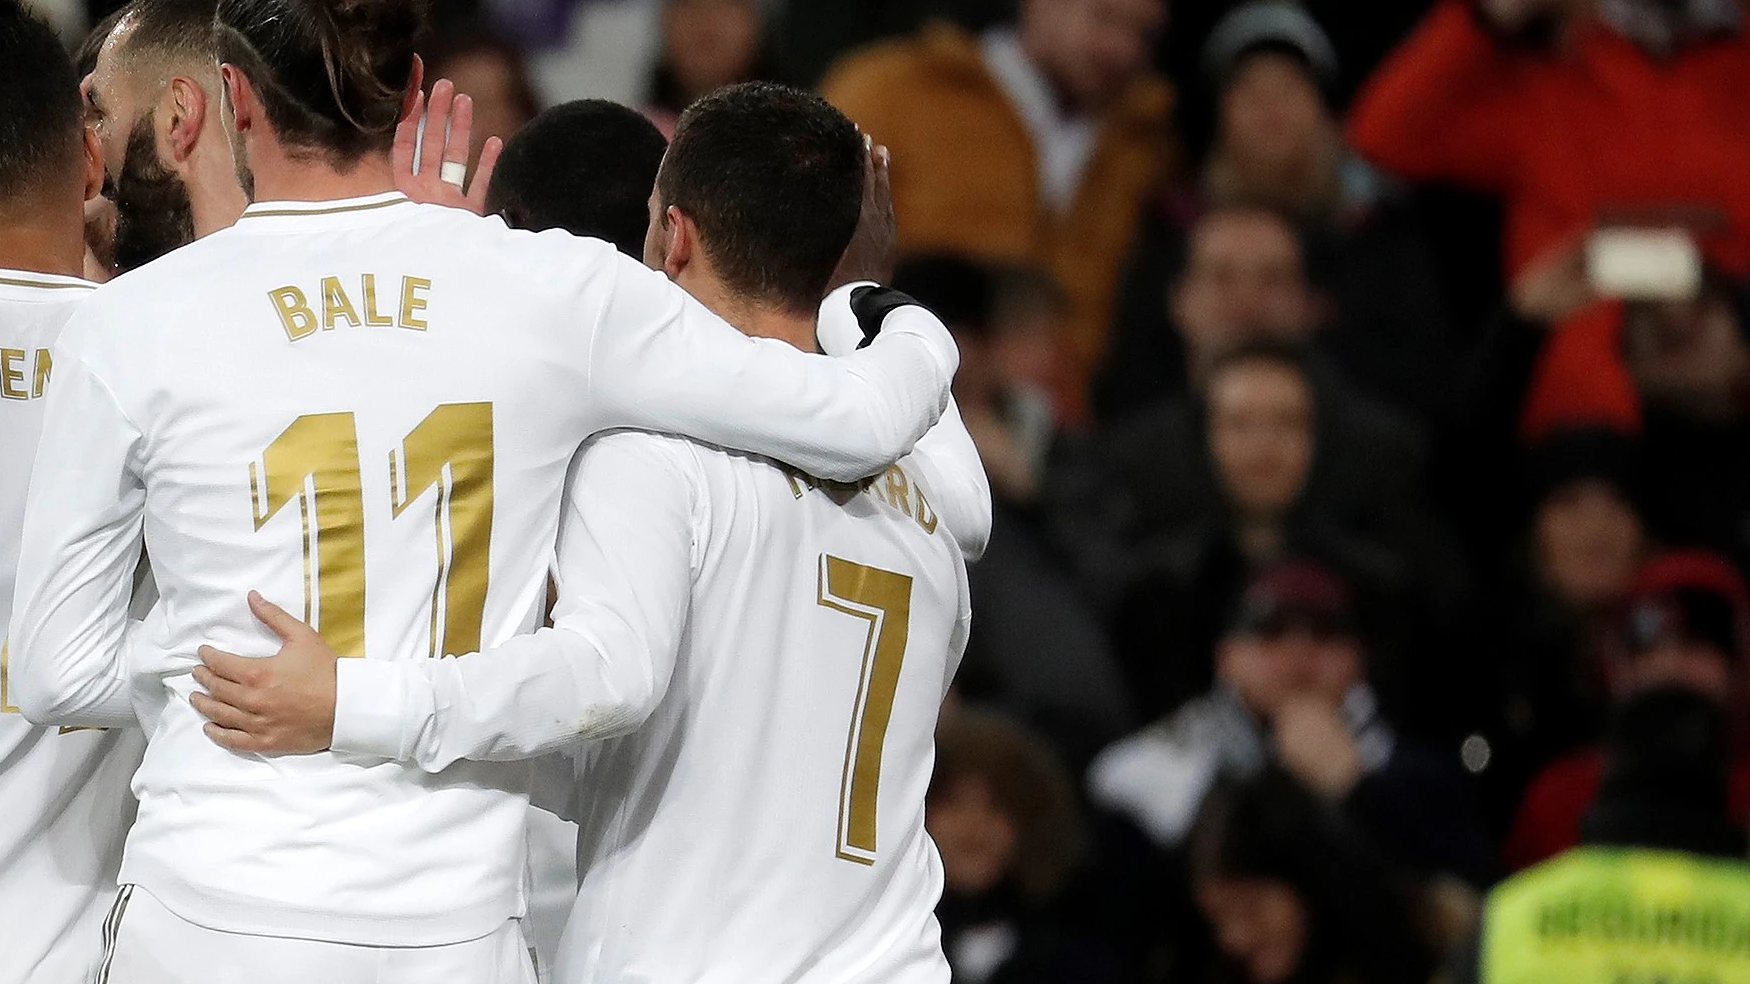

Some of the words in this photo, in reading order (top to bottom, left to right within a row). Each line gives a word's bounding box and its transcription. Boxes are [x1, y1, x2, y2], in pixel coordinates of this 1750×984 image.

[268, 273, 432, 342] BALE
[248, 401, 495, 659] 11
[816, 552, 915, 867] 7
